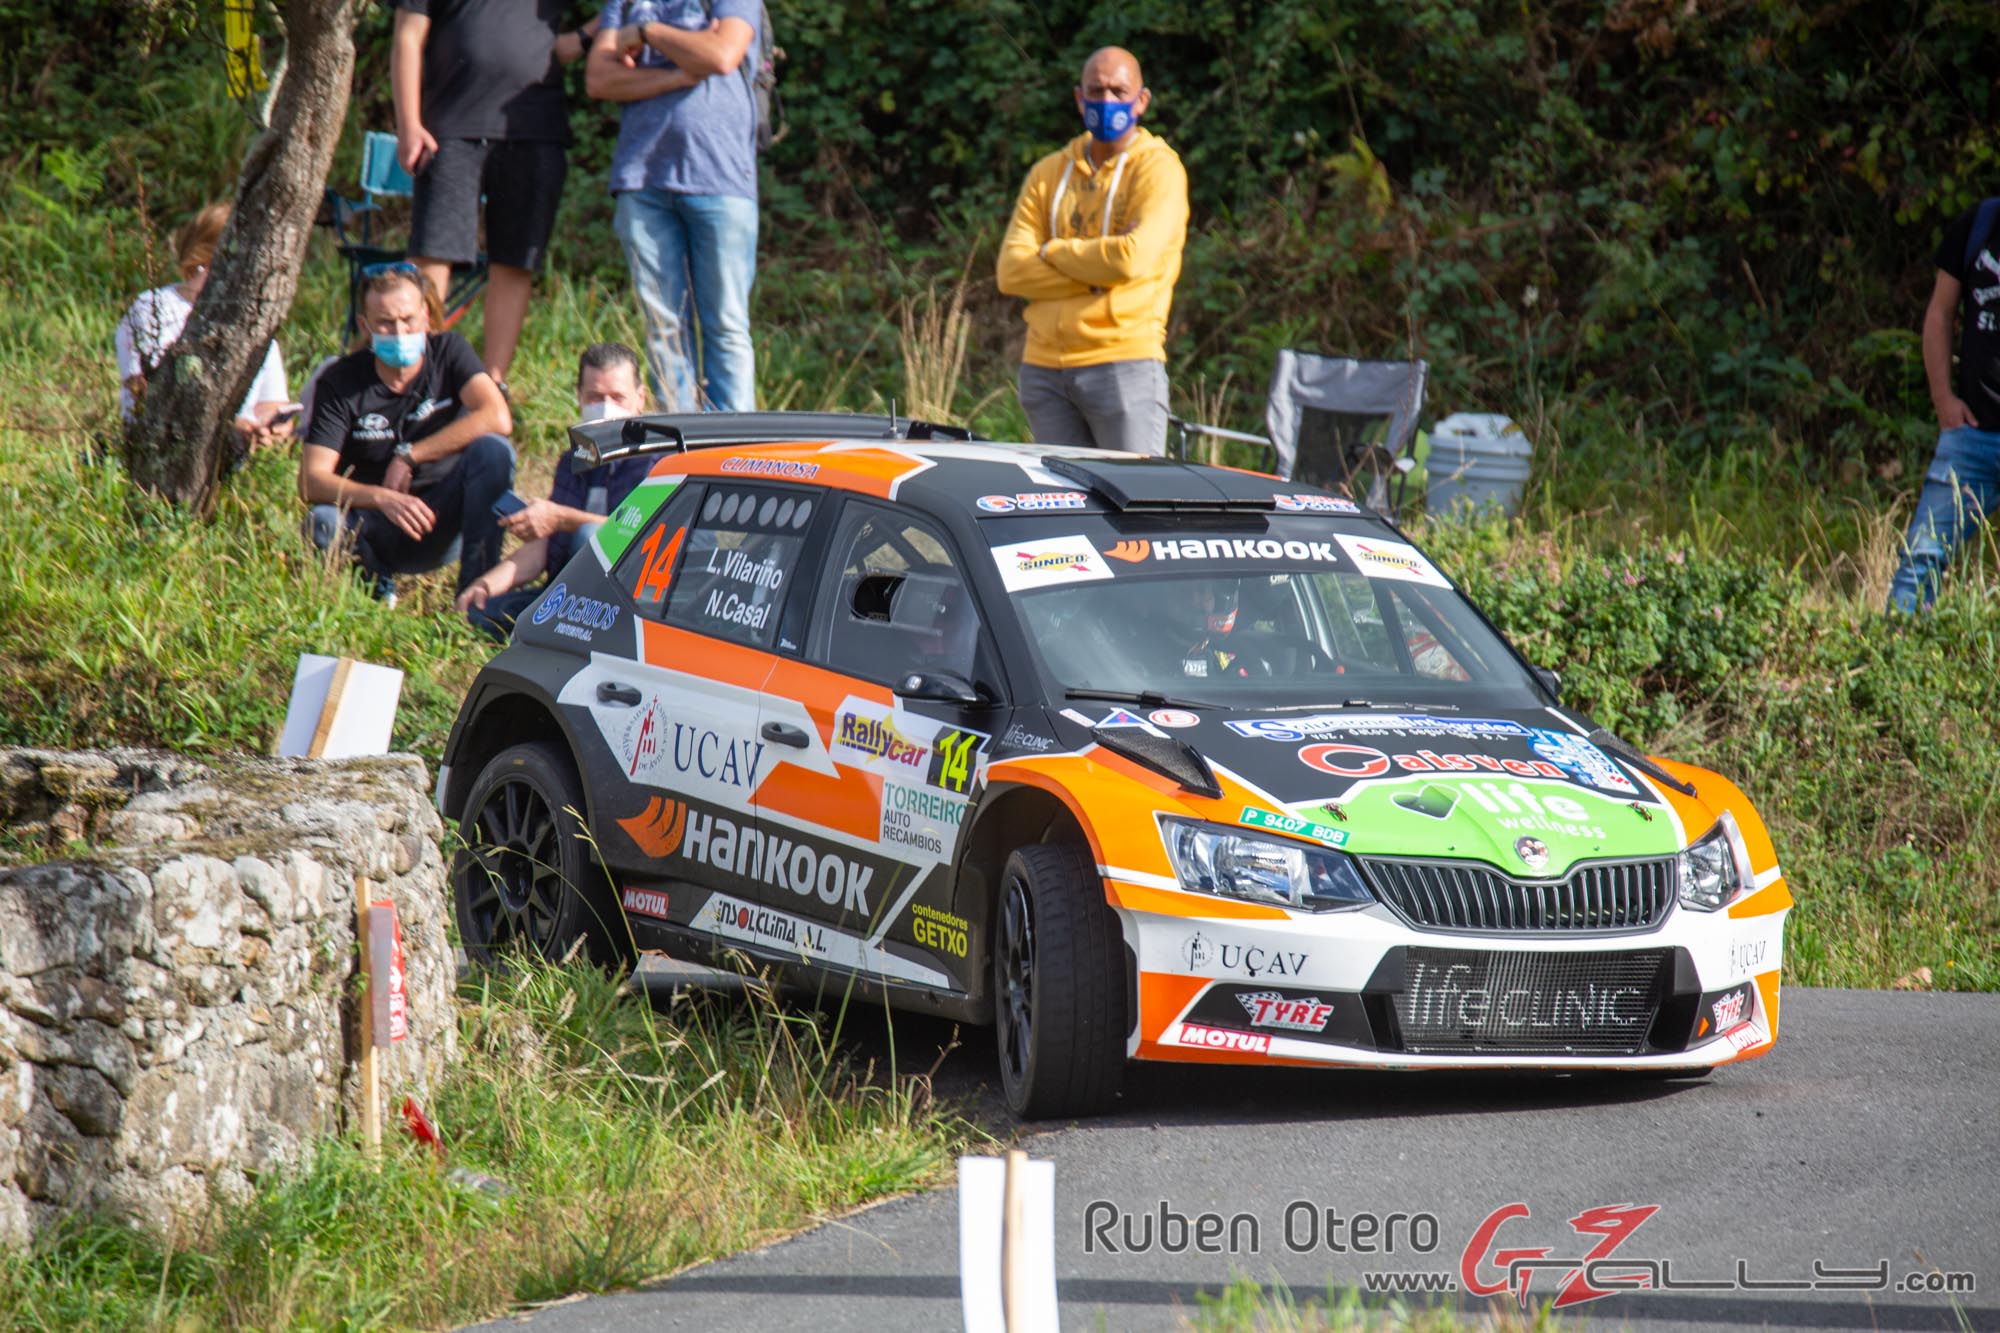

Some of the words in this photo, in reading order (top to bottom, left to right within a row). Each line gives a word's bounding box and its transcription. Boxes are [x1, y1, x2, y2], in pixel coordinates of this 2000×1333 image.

[720, 457, 820, 480] CLIMANOSA
[622, 505, 642, 528] life
[633, 522, 686, 603] 14
[1021, 554, 1086, 571] SUNOCO
[1362, 552, 1420, 569] SUNOCO
[673, 722, 766, 790] UCAV
[938, 730, 974, 793] 14
[1459, 782, 1590, 821] life
[884, 808, 911, 829] AUTO
[1244, 811, 1257, 824] P
[1263, 814, 1307, 834] 9407
[1311, 823, 1345, 844] BDB
[1497, 815, 1606, 839] wellness
[883, 824, 942, 854] RECAMBIOS
[624, 889, 668, 917] MOTUL
[912, 903, 969, 931] contenedores
[913, 916, 968, 959] GETXO
[1220, 943, 1308, 976] UCAV
[1254, 998, 1334, 1026] TYRE
[1182, 1026, 1268, 1052] MOTUL
